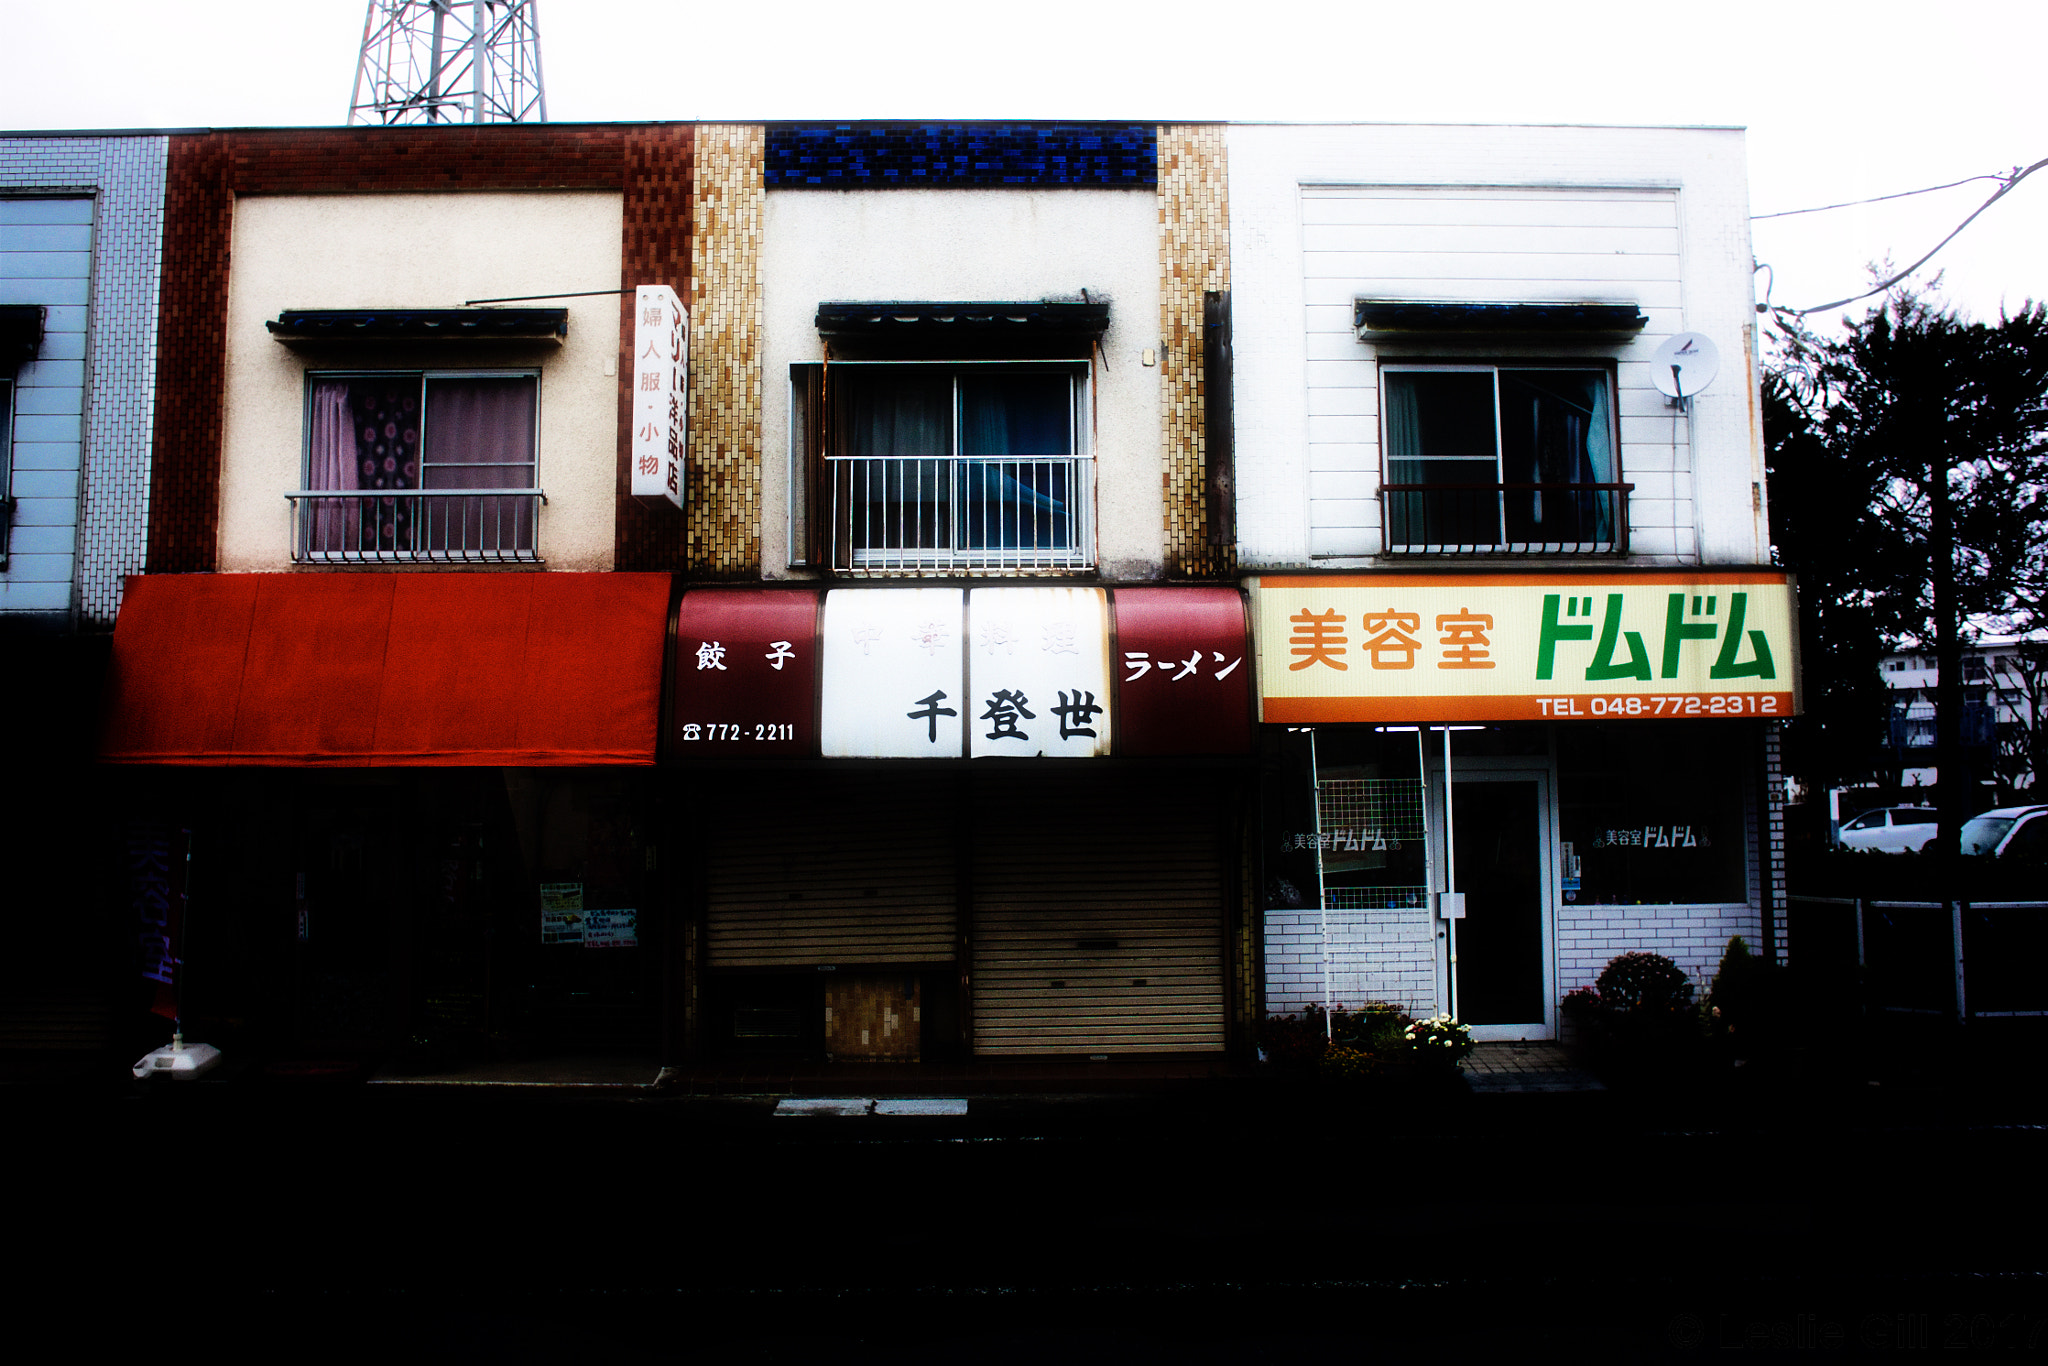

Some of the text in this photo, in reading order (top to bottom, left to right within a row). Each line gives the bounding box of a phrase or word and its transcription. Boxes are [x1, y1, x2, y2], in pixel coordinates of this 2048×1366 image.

[639, 308, 662, 475] 婦人服・小物
[853, 622, 1079, 656] 中華料理
[1289, 593, 1776, 681] 美容室 ドムドム
[696, 641, 796, 671] 餃子
[1125, 650, 1241, 682] ラーメン
[907, 689, 1103, 743] 千登世
[1536, 696, 1776, 715] TEL 048-772-2312
[707, 724, 794, 742] 772-2211
